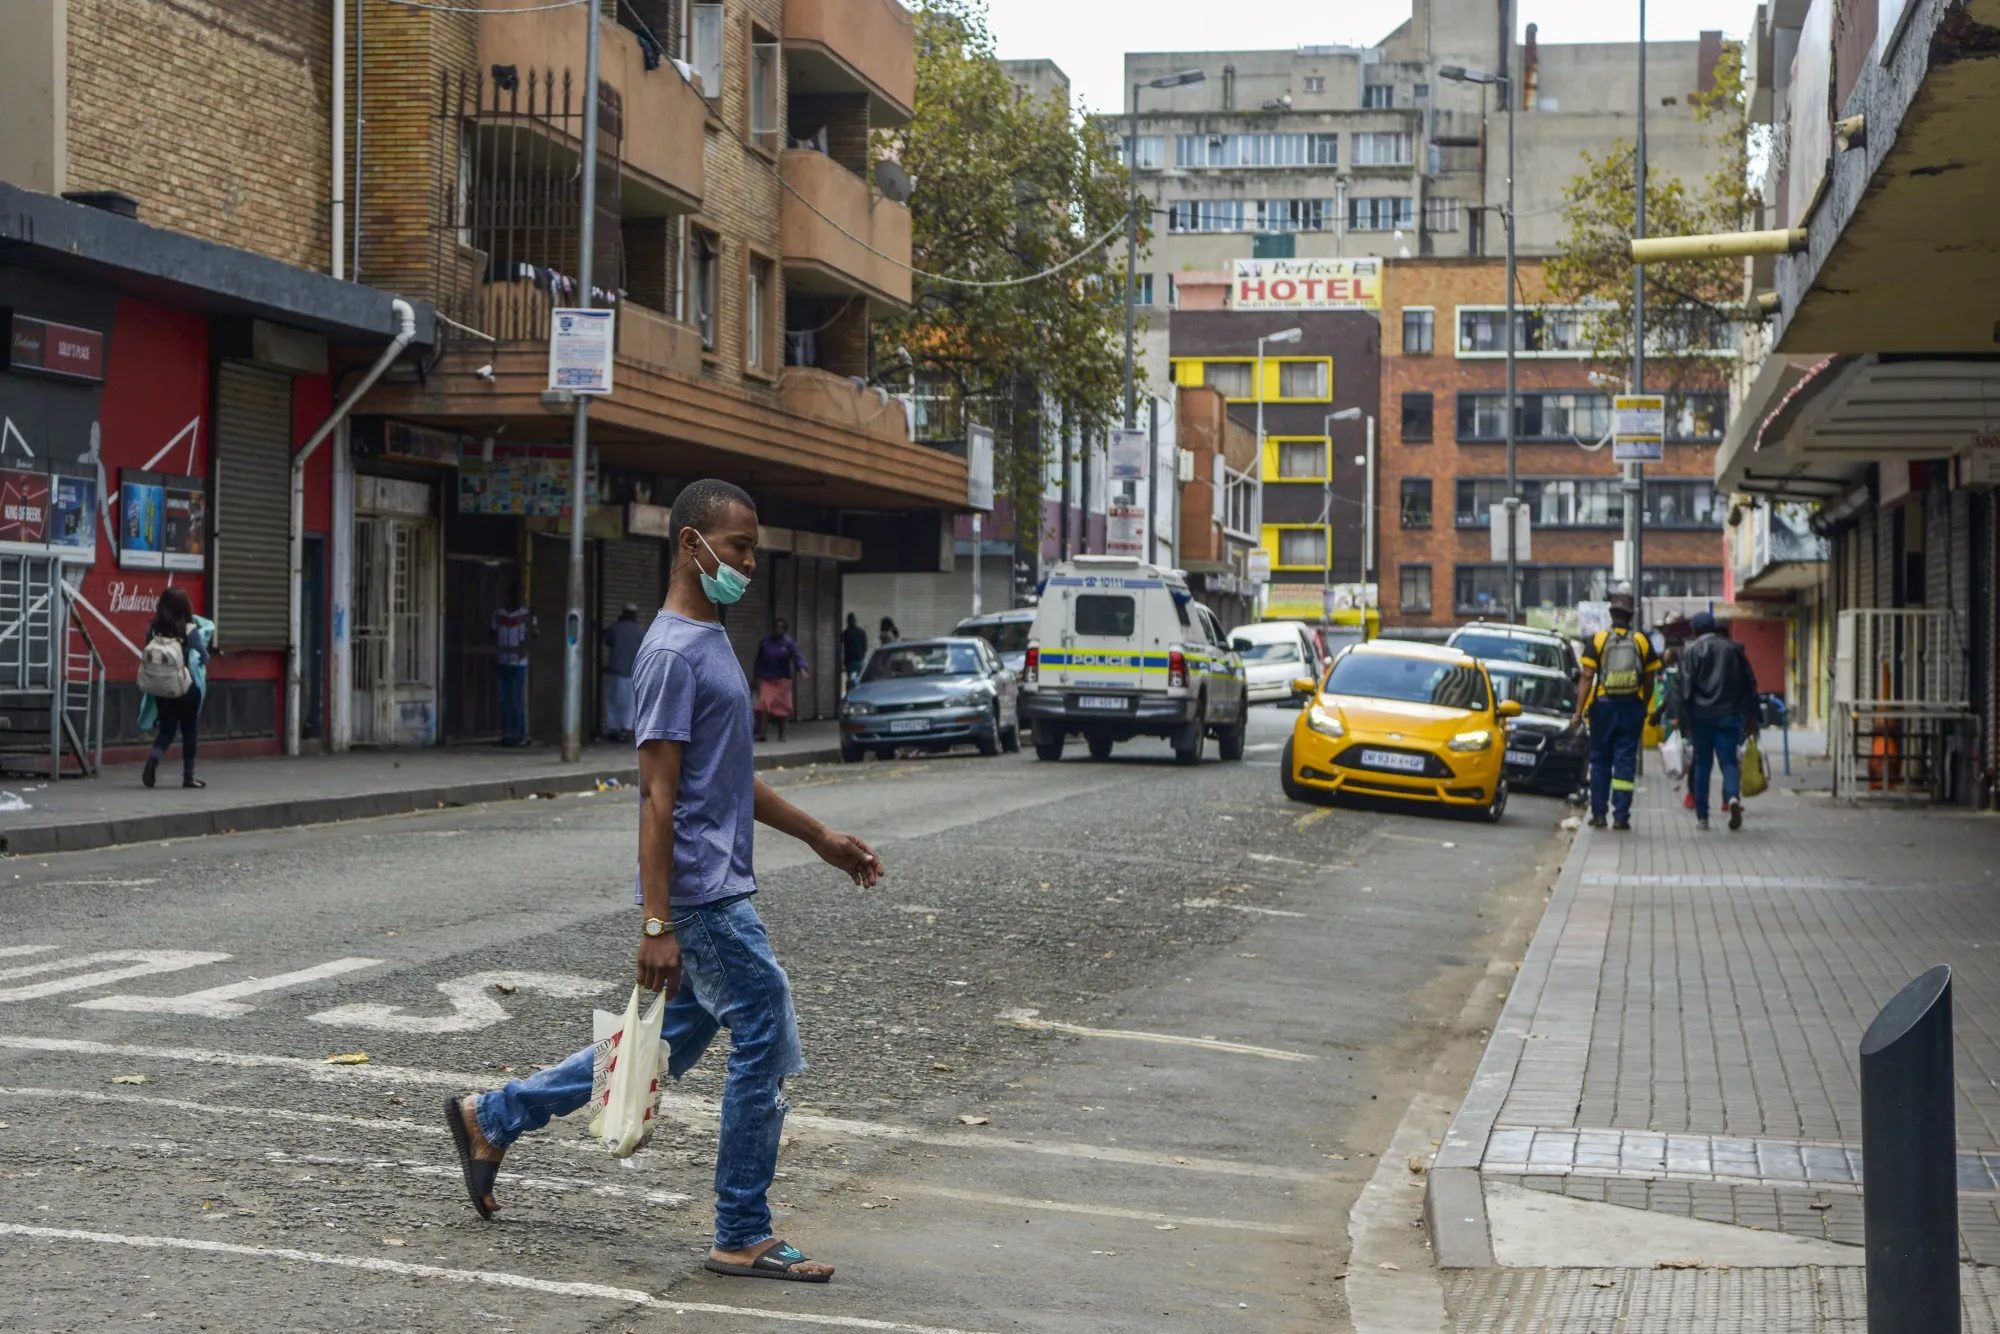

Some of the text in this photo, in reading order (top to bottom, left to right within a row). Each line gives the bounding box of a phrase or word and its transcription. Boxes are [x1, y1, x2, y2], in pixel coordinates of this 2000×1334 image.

[1272, 260, 1343, 279] Perfect
[1240, 279, 1374, 301] HOTEL
[5, 505, 18, 520] KING
[1100, 577, 1124, 588] 10111
[108, 581, 160, 613] Budweise
[1072, 654, 1132, 666] POLICE
